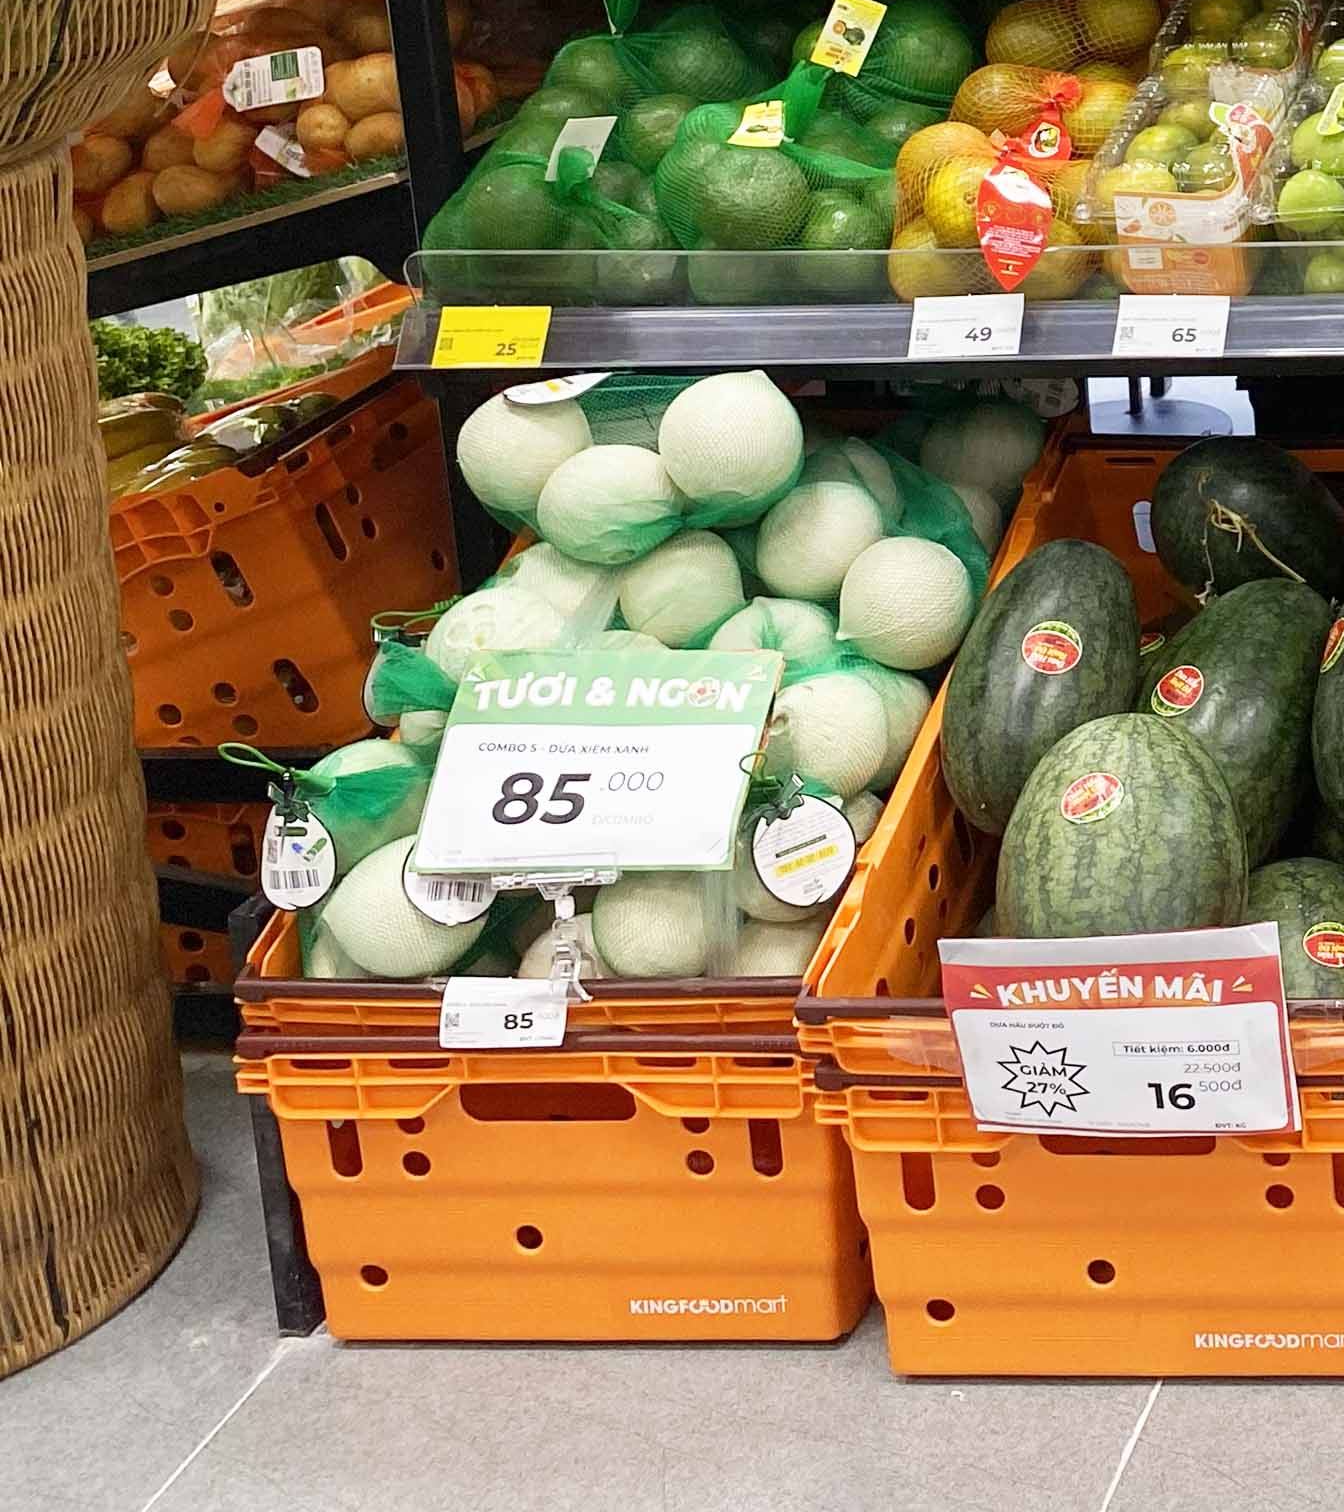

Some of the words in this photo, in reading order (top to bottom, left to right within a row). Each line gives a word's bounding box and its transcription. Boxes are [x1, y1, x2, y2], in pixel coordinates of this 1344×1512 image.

[965, 326, 993, 341] 49
[1171, 328, 1197, 342] 65
[495, 343, 517, 356] 25
[472, 673, 575, 713] TƯƠI
[585, 676, 616, 705] &
[626, 675, 752, 712] NGON
[478, 742, 528, 753] COMBO
[613, 744, 650, 754] XANH
[492, 772, 592, 825] 85
[997, 968, 1144, 1008] KHUYẾN
[1154, 974, 1224, 1004] MÃI
[504, 1012, 534, 1030] 85
[1123, 1044, 1148, 1054] Tiết
[1187, 1043, 1231, 1054] 6.000đ
[1019, 1062, 1068, 1078] GIẢM
[1026, 1081, 1067, 1096] 27%
[1147, 1082, 1197, 1110] 16
[630, 1294, 789, 1316] KINGFOODmart
